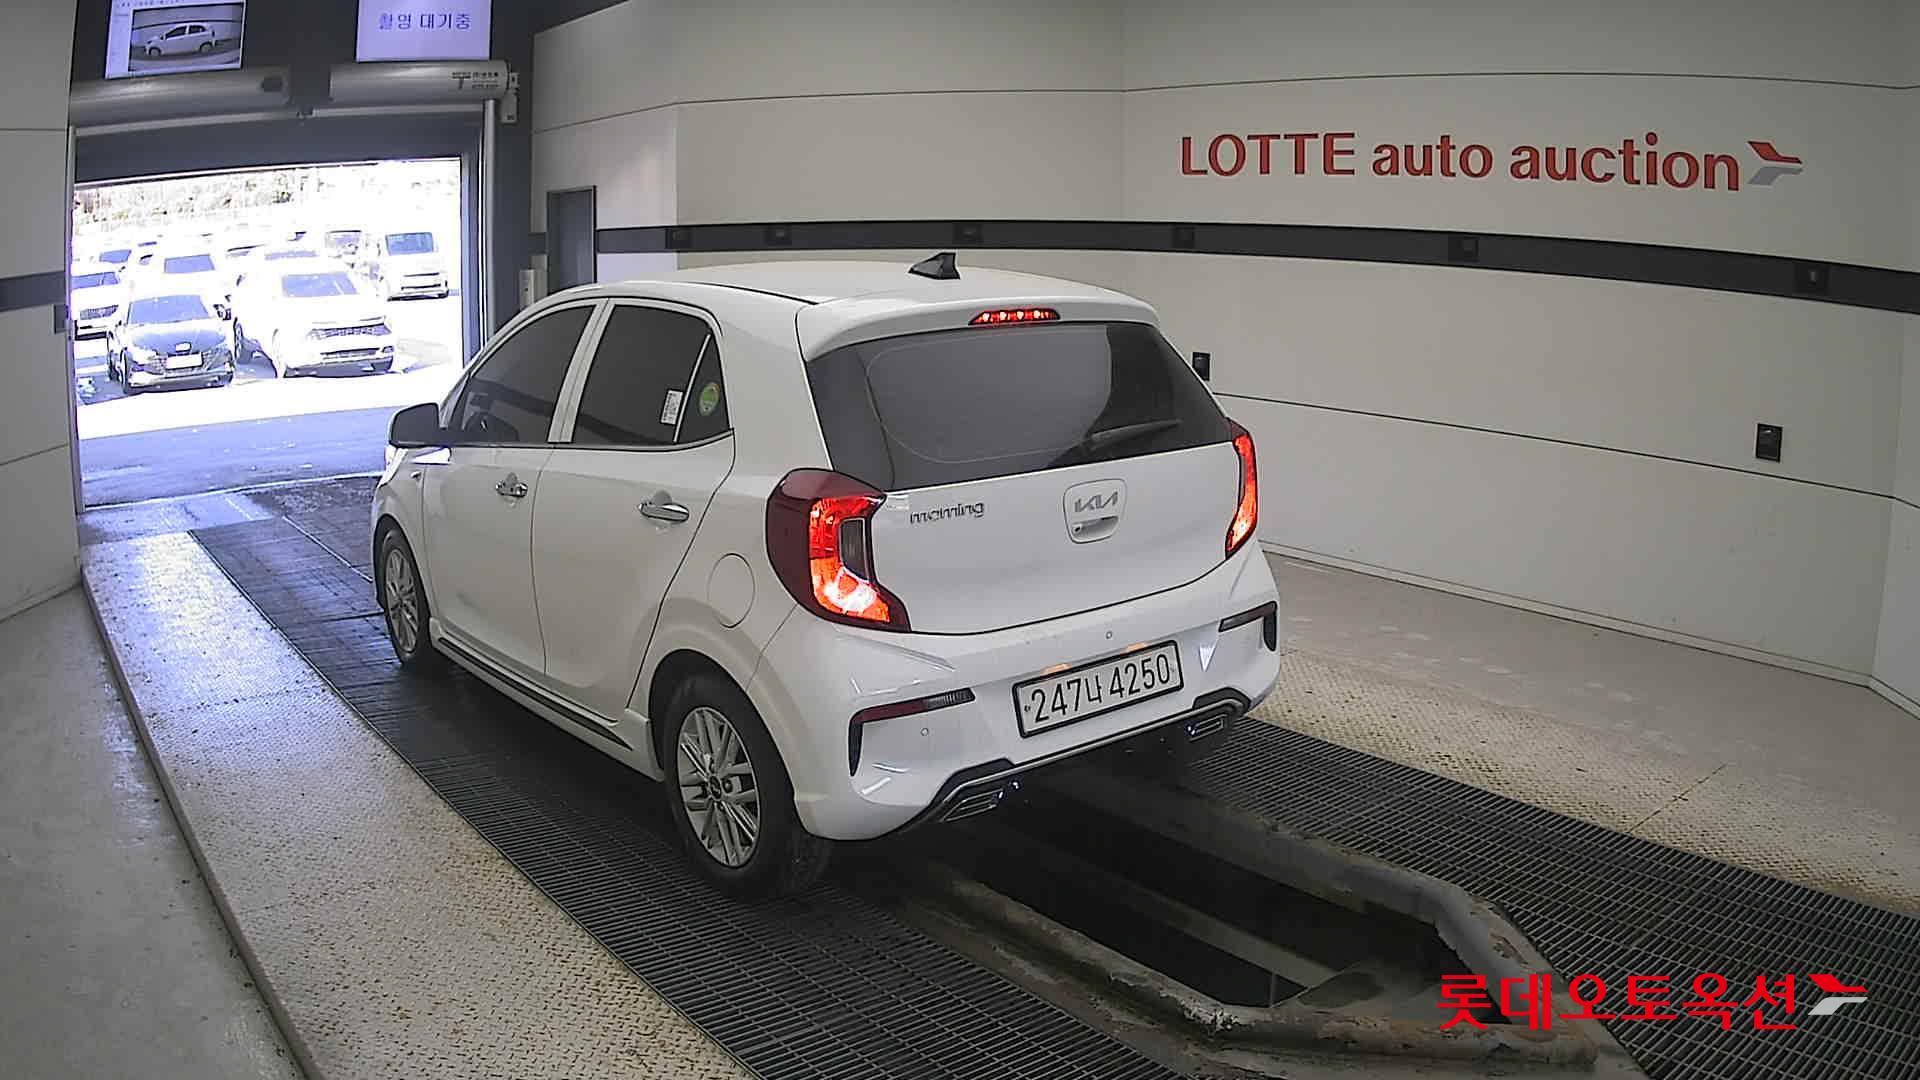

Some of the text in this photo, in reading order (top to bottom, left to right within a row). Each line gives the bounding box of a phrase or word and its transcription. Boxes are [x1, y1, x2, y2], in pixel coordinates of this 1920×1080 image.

[420, 13, 473, 30] 대기중
[1181, 131, 1740, 192] LOTTE auto auction
[909, 502, 985, 525] morning
[1031, 653, 1171, 724] 247나 4250
